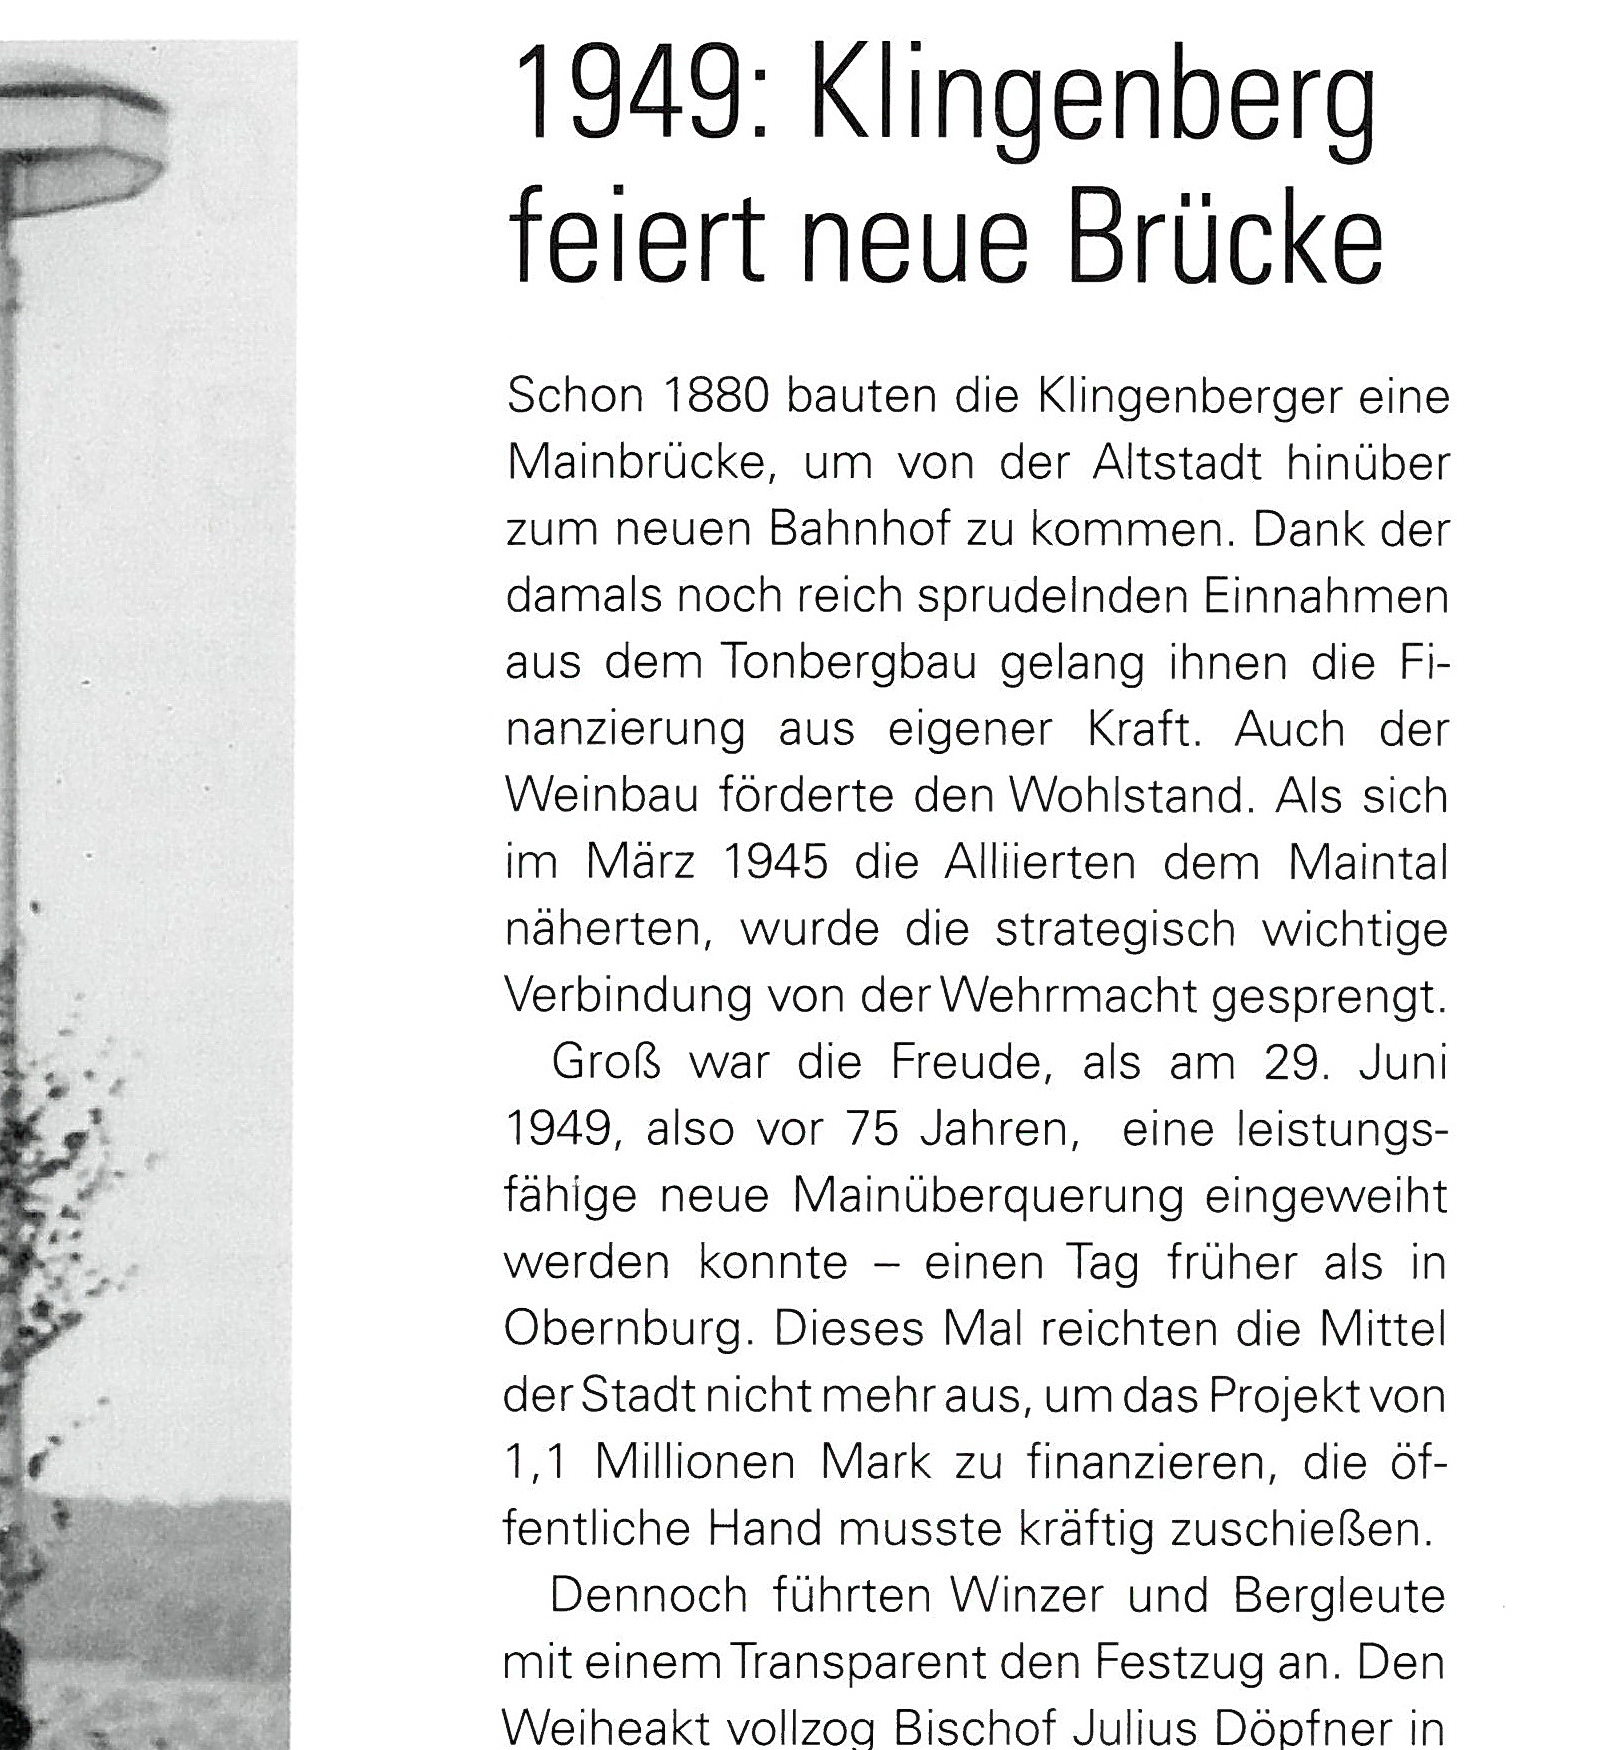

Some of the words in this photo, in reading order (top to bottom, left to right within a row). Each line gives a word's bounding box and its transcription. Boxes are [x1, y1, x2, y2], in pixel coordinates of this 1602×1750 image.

[519, 41, 766, 139] 1949:
[814, 40, 1374, 166] Klingenberg
[508, 183, 766, 284] feiert
[804, 212, 1028, 284] neue
[1070, 185, 1382, 286] Brücke
[508, 374, 643, 413] Schon
[665, 375, 769, 413] 1880
[788, 374, 936, 413] bauten
[955, 375, 1019, 413] die
[1040, 375, 1344, 424] Klingenberger
[1359, 376, 1450, 415] eine
[506, 518, 597, 546] zum
[617, 517, 750, 547] neuen
[771, 507, 952, 547] Bahnhof
[967, 519, 1013, 547] zu
[1032, 508, 1234, 547] kommen.
[1255, 509, 1366, 548] Dank
[1381, 509, 1452, 548] der
[506, 651, 581, 680] aus
[605, 641, 702, 679] dem
[720, 641, 976, 688] Tonbergbau
[1001, 641, 1144, 689] gelang
[1171, 642, 1286, 681] ihnen
[1312, 642, 1375, 681] die
[1401, 642, 1451, 680] Fi-
[504, 774, 697, 813] Weinbau
[718, 773, 894, 813] förderte
[914, 774, 993, 813] den
[1008, 775, 1254, 814] Wohlstand.
[1274, 775, 1342, 814] Als
[1363, 775, 1447, 814] sich
[507, 907, 712, 952] näherten,
[739, 908, 880, 946] wurde
[906, 908, 969, 946] die
[995, 908, 1235, 956] strategisch
[1261, 909, 1448, 956] wichtige
[553, 1040, 661, 1080] Groß
[688, 1051, 771, 1080] war
[798, 1041, 862, 1080] die
[893, 1041, 1052, 1085] Freude,
[1083, 1041, 1141, 1080] als
[1170, 1052, 1235, 1080] am
[1265, 1043, 1329, 1081] 29.
[1359, 1042, 1447, 1081] Juni
[503, 1173, 637, 1222] fähige
[662, 1184, 769, 1213] neue
[795, 1174, 1183, 1222] Mainüberquerung
[1206, 1175, 1448, 1223] eingeweiht
[504, 1307, 753, 1355] Obernburg.
[776, 1308, 924, 1347] Dieses
[945, 1308, 1021, 1347] Mal
[1042, 1308, 1217, 1347] reichten
[1236, 1308, 1301, 1347] die
[1322, 1308, 1445, 1347] Mittel
[507, 1442, 561, 1485] 1,1
[597, 1441, 794, 1480] Millionen
[823, 1441, 932, 1480] Mark
[955, 1452, 1002, 1480] zu
[1026, 1441, 1276, 1486] finanzieren,
[1304, 1441, 1367, 1480] die
[1391, 1441, 1448, 1480] öf-
[552, 1574, 747, 1613] Dennoch
[772, 1574, 930, 1613] führten
[949, 1574, 1105, 1613] Winzer
[1129, 1575, 1208, 1613] und
[1235, 1575, 1445, 1622] Bergleute
[501, 1707, 711, 1746] Weiheakt
[896, 1707, 1057, 1747] Bischof
[1072, 1708, 1197, 1747] Julius
[1411, 1708, 1444, 1747] in
